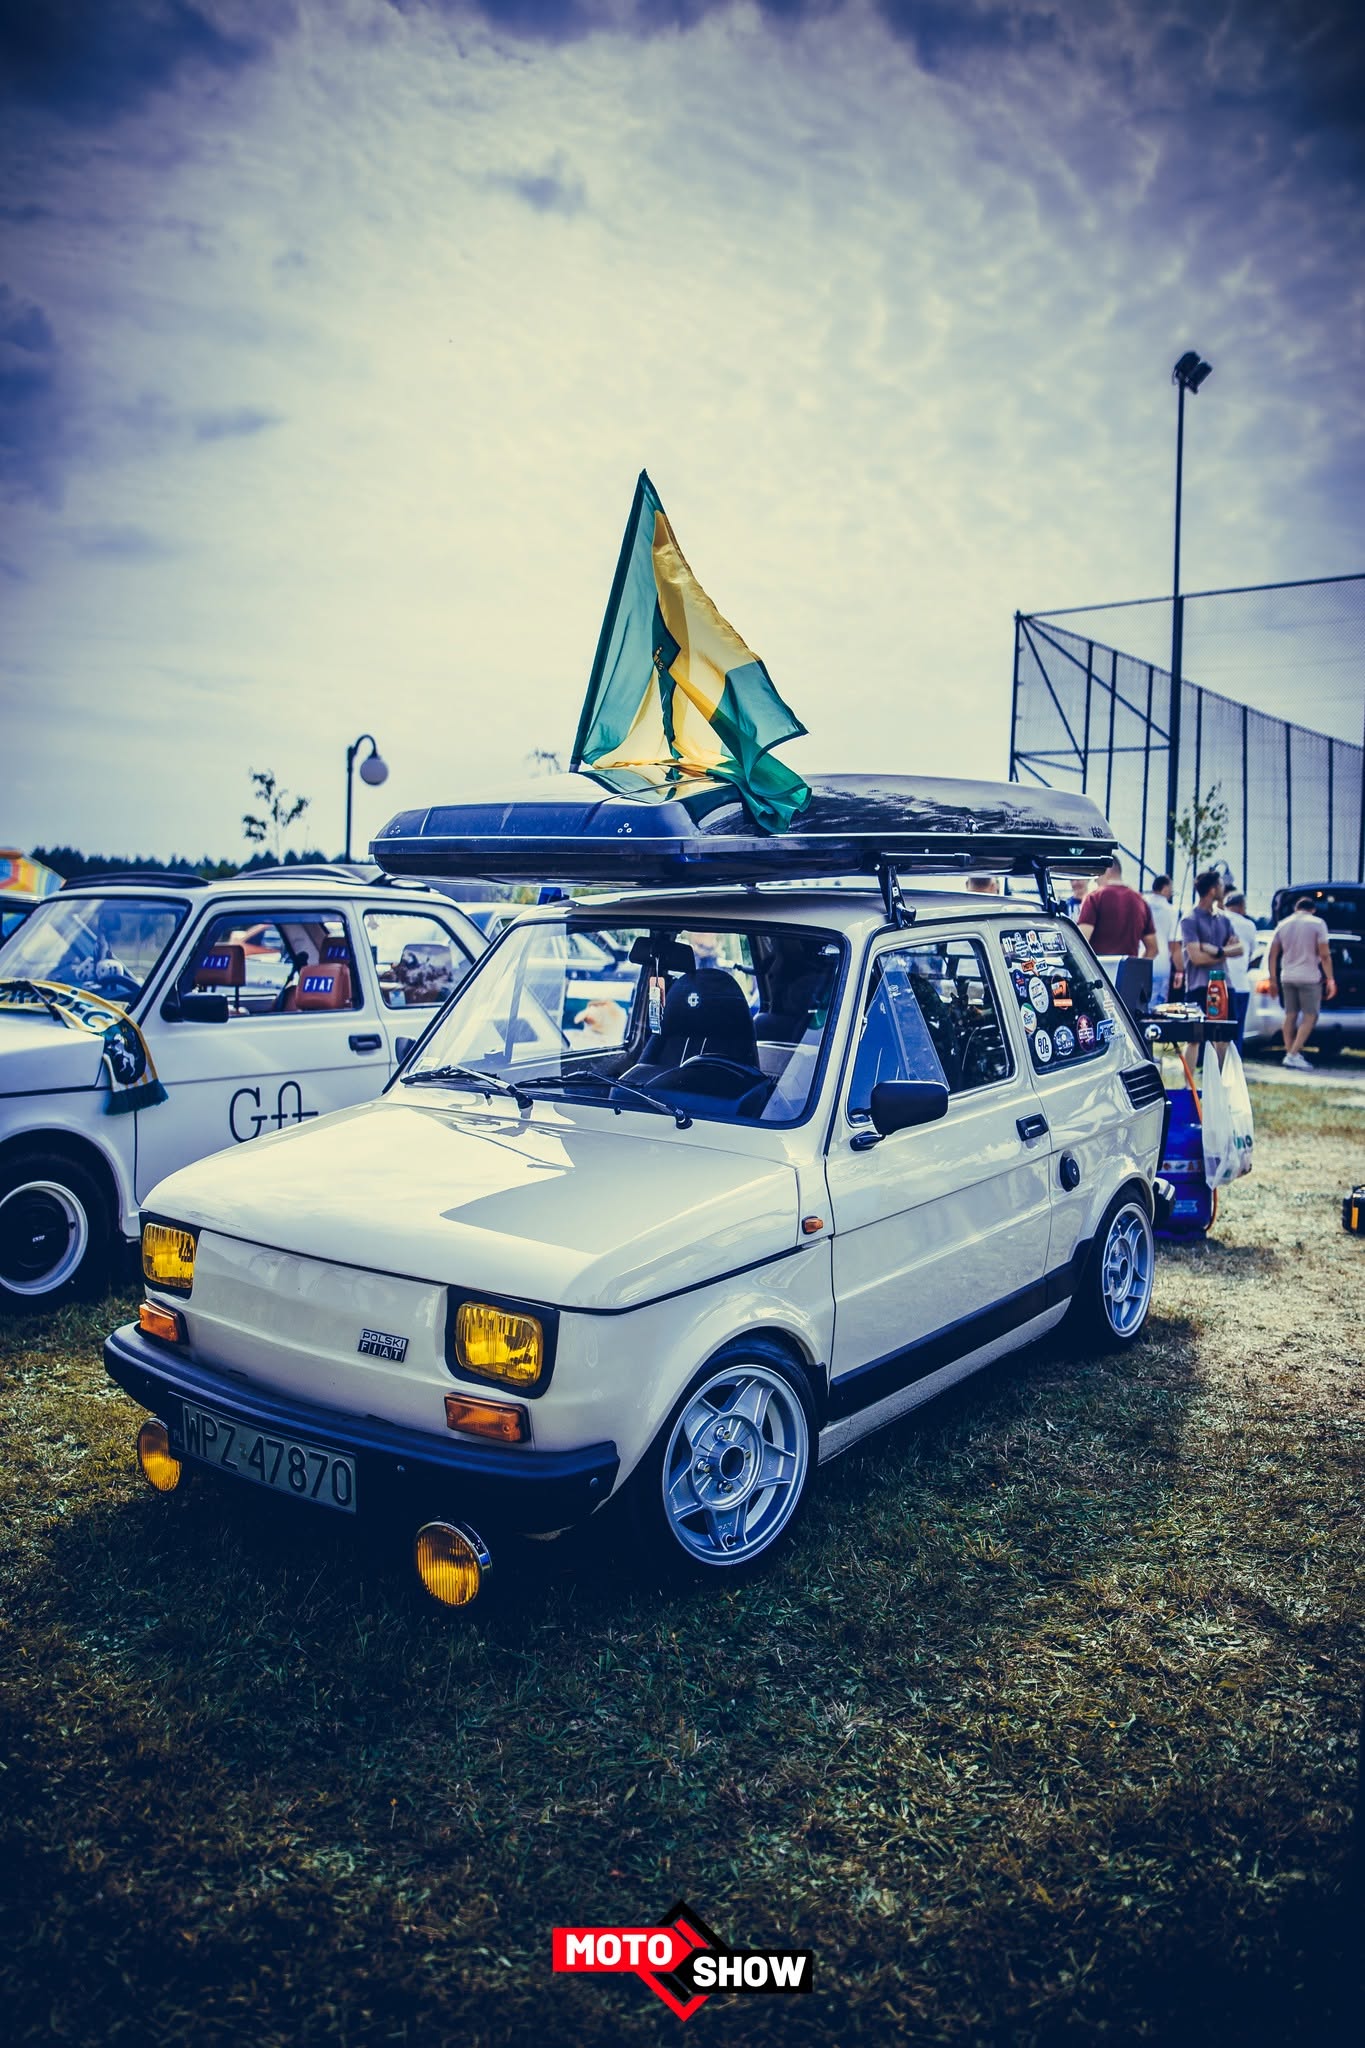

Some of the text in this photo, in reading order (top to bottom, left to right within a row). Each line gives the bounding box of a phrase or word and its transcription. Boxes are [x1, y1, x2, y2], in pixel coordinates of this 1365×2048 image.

[203, 956, 229, 968] FIAT
[304, 977, 333, 992] FIAT
[362, 1331, 405, 1348] POLSKI
[360, 1341, 402, 1360] FIAT
[184, 1405, 353, 1507] WPZ 47870
